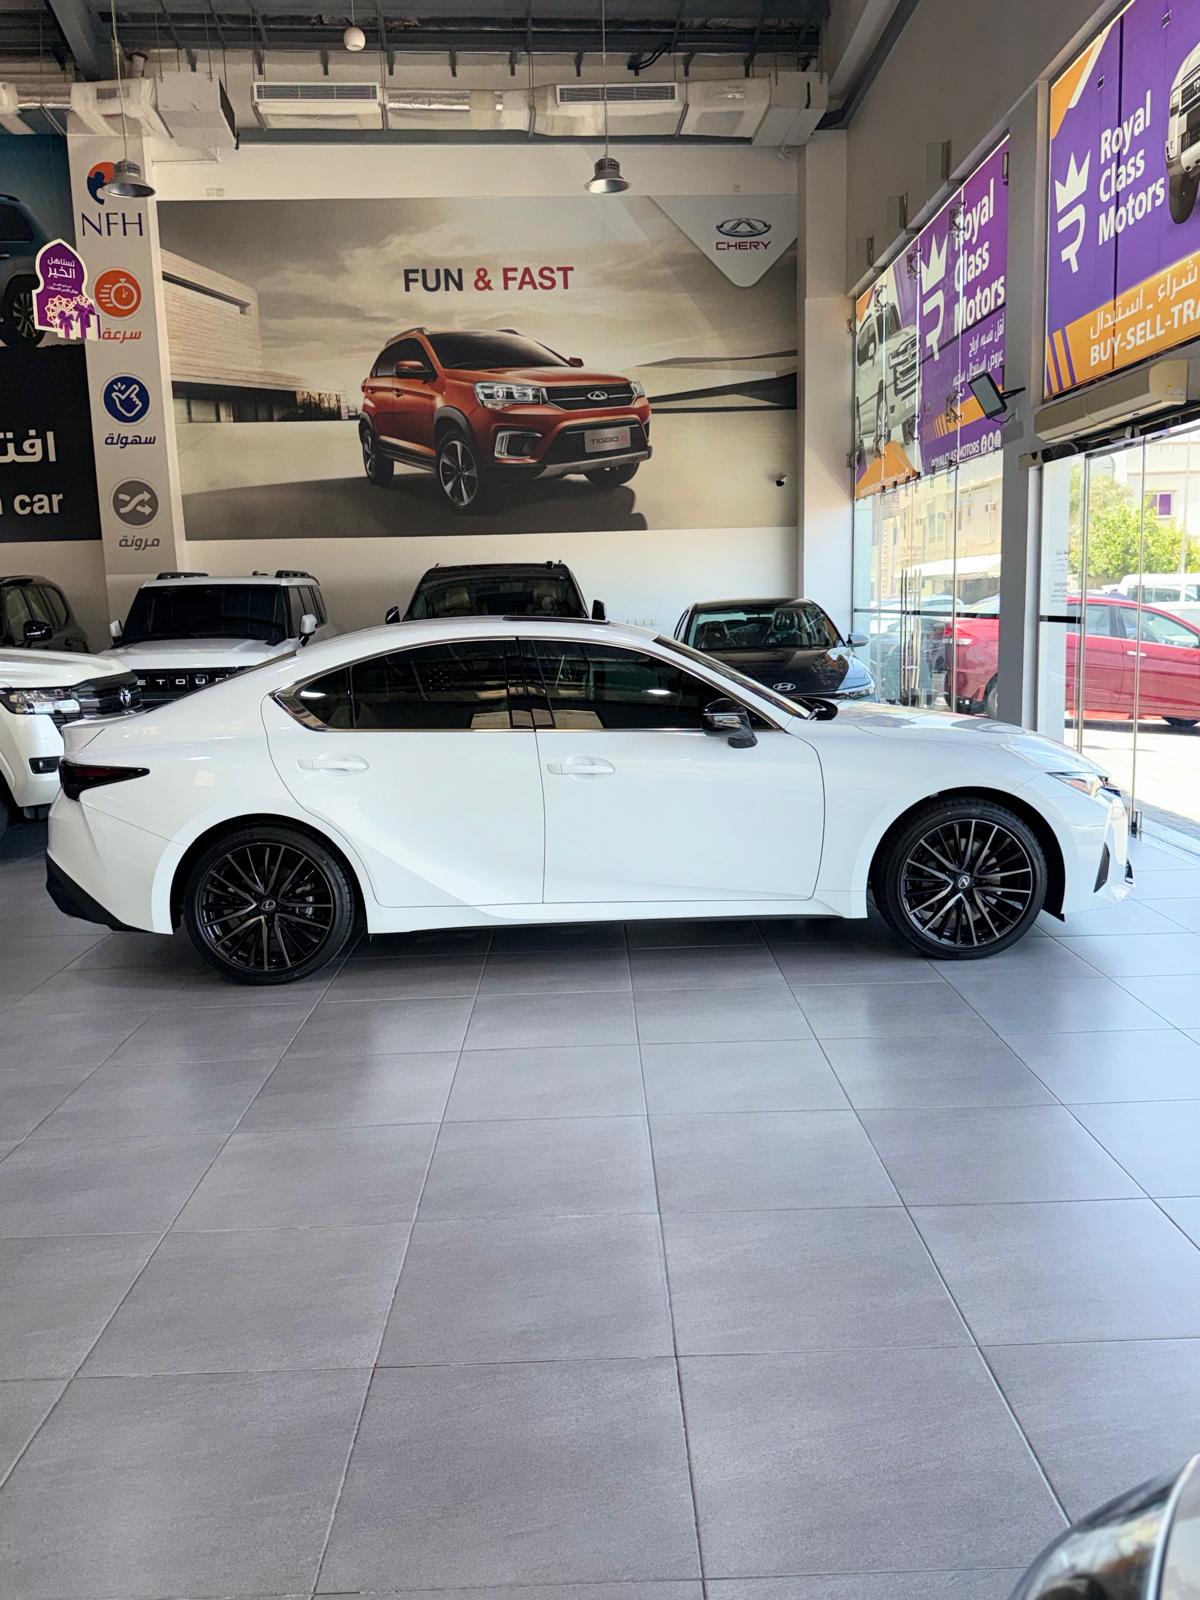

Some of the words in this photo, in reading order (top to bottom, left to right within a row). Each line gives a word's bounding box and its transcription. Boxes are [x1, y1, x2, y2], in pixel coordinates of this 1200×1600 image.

[1101, 89, 1151, 165] Royal
[1100, 149, 1145, 202] Class
[81, 212, 143, 236] NFH
[1098, 177, 1165, 246] Motors
[716, 240, 771, 251] CHERY
[48, 266, 76, 279] الخير
[403, 268, 464, 292] FUN
[473, 267, 494, 291] &
[502, 266, 574, 291] FAST
[954, 241, 989, 292] Class
[1157, 260, 1198, 302] شراء
[954, 275, 1005, 337] Motors
[102, 328, 142, 344] سرعة
[0, 429, 56, 463] افت
[104, 433, 156, 449] سهولة
[13, 492, 64, 515] car
[118, 535, 160, 551] مرونة
